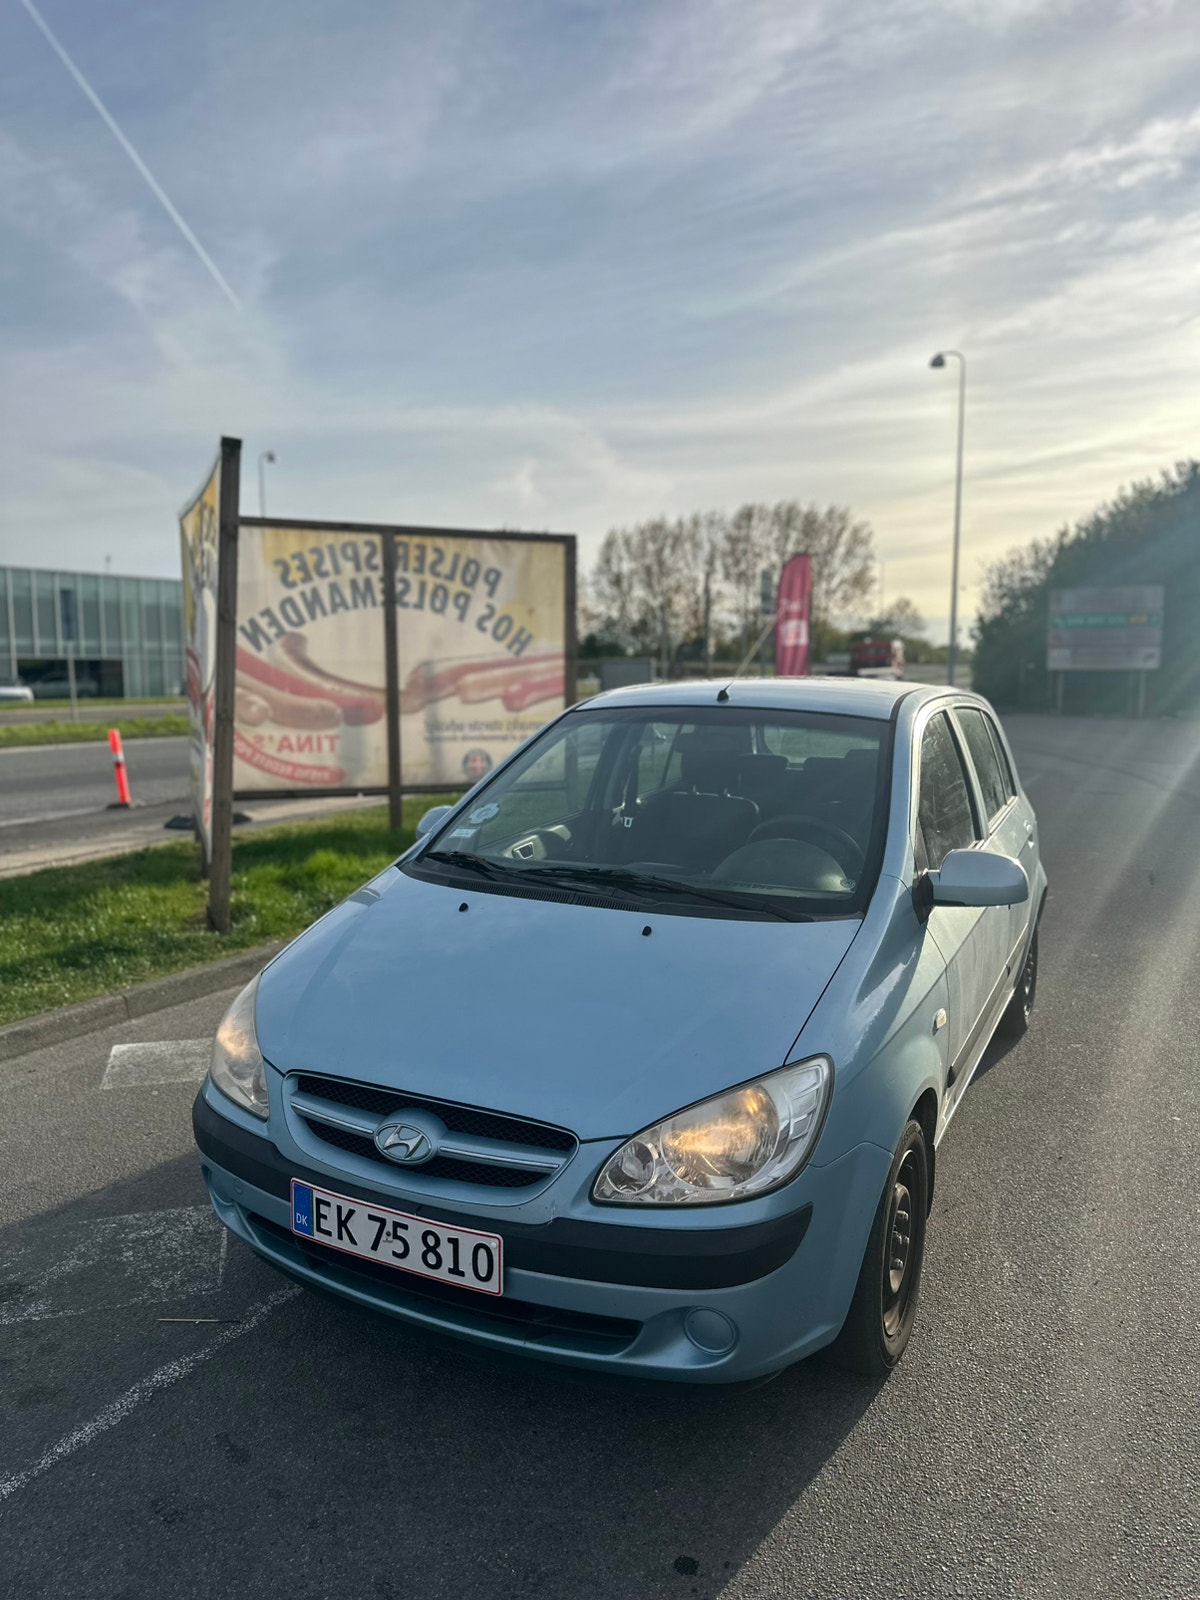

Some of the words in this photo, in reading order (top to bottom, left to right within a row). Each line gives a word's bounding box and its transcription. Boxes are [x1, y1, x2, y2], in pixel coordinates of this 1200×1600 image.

[296, 1212, 308, 1227] DK
[315, 1197, 358, 1246] EK
[367, 1213, 410, 1259] 75
[421, 1229, 494, 1282] 810
